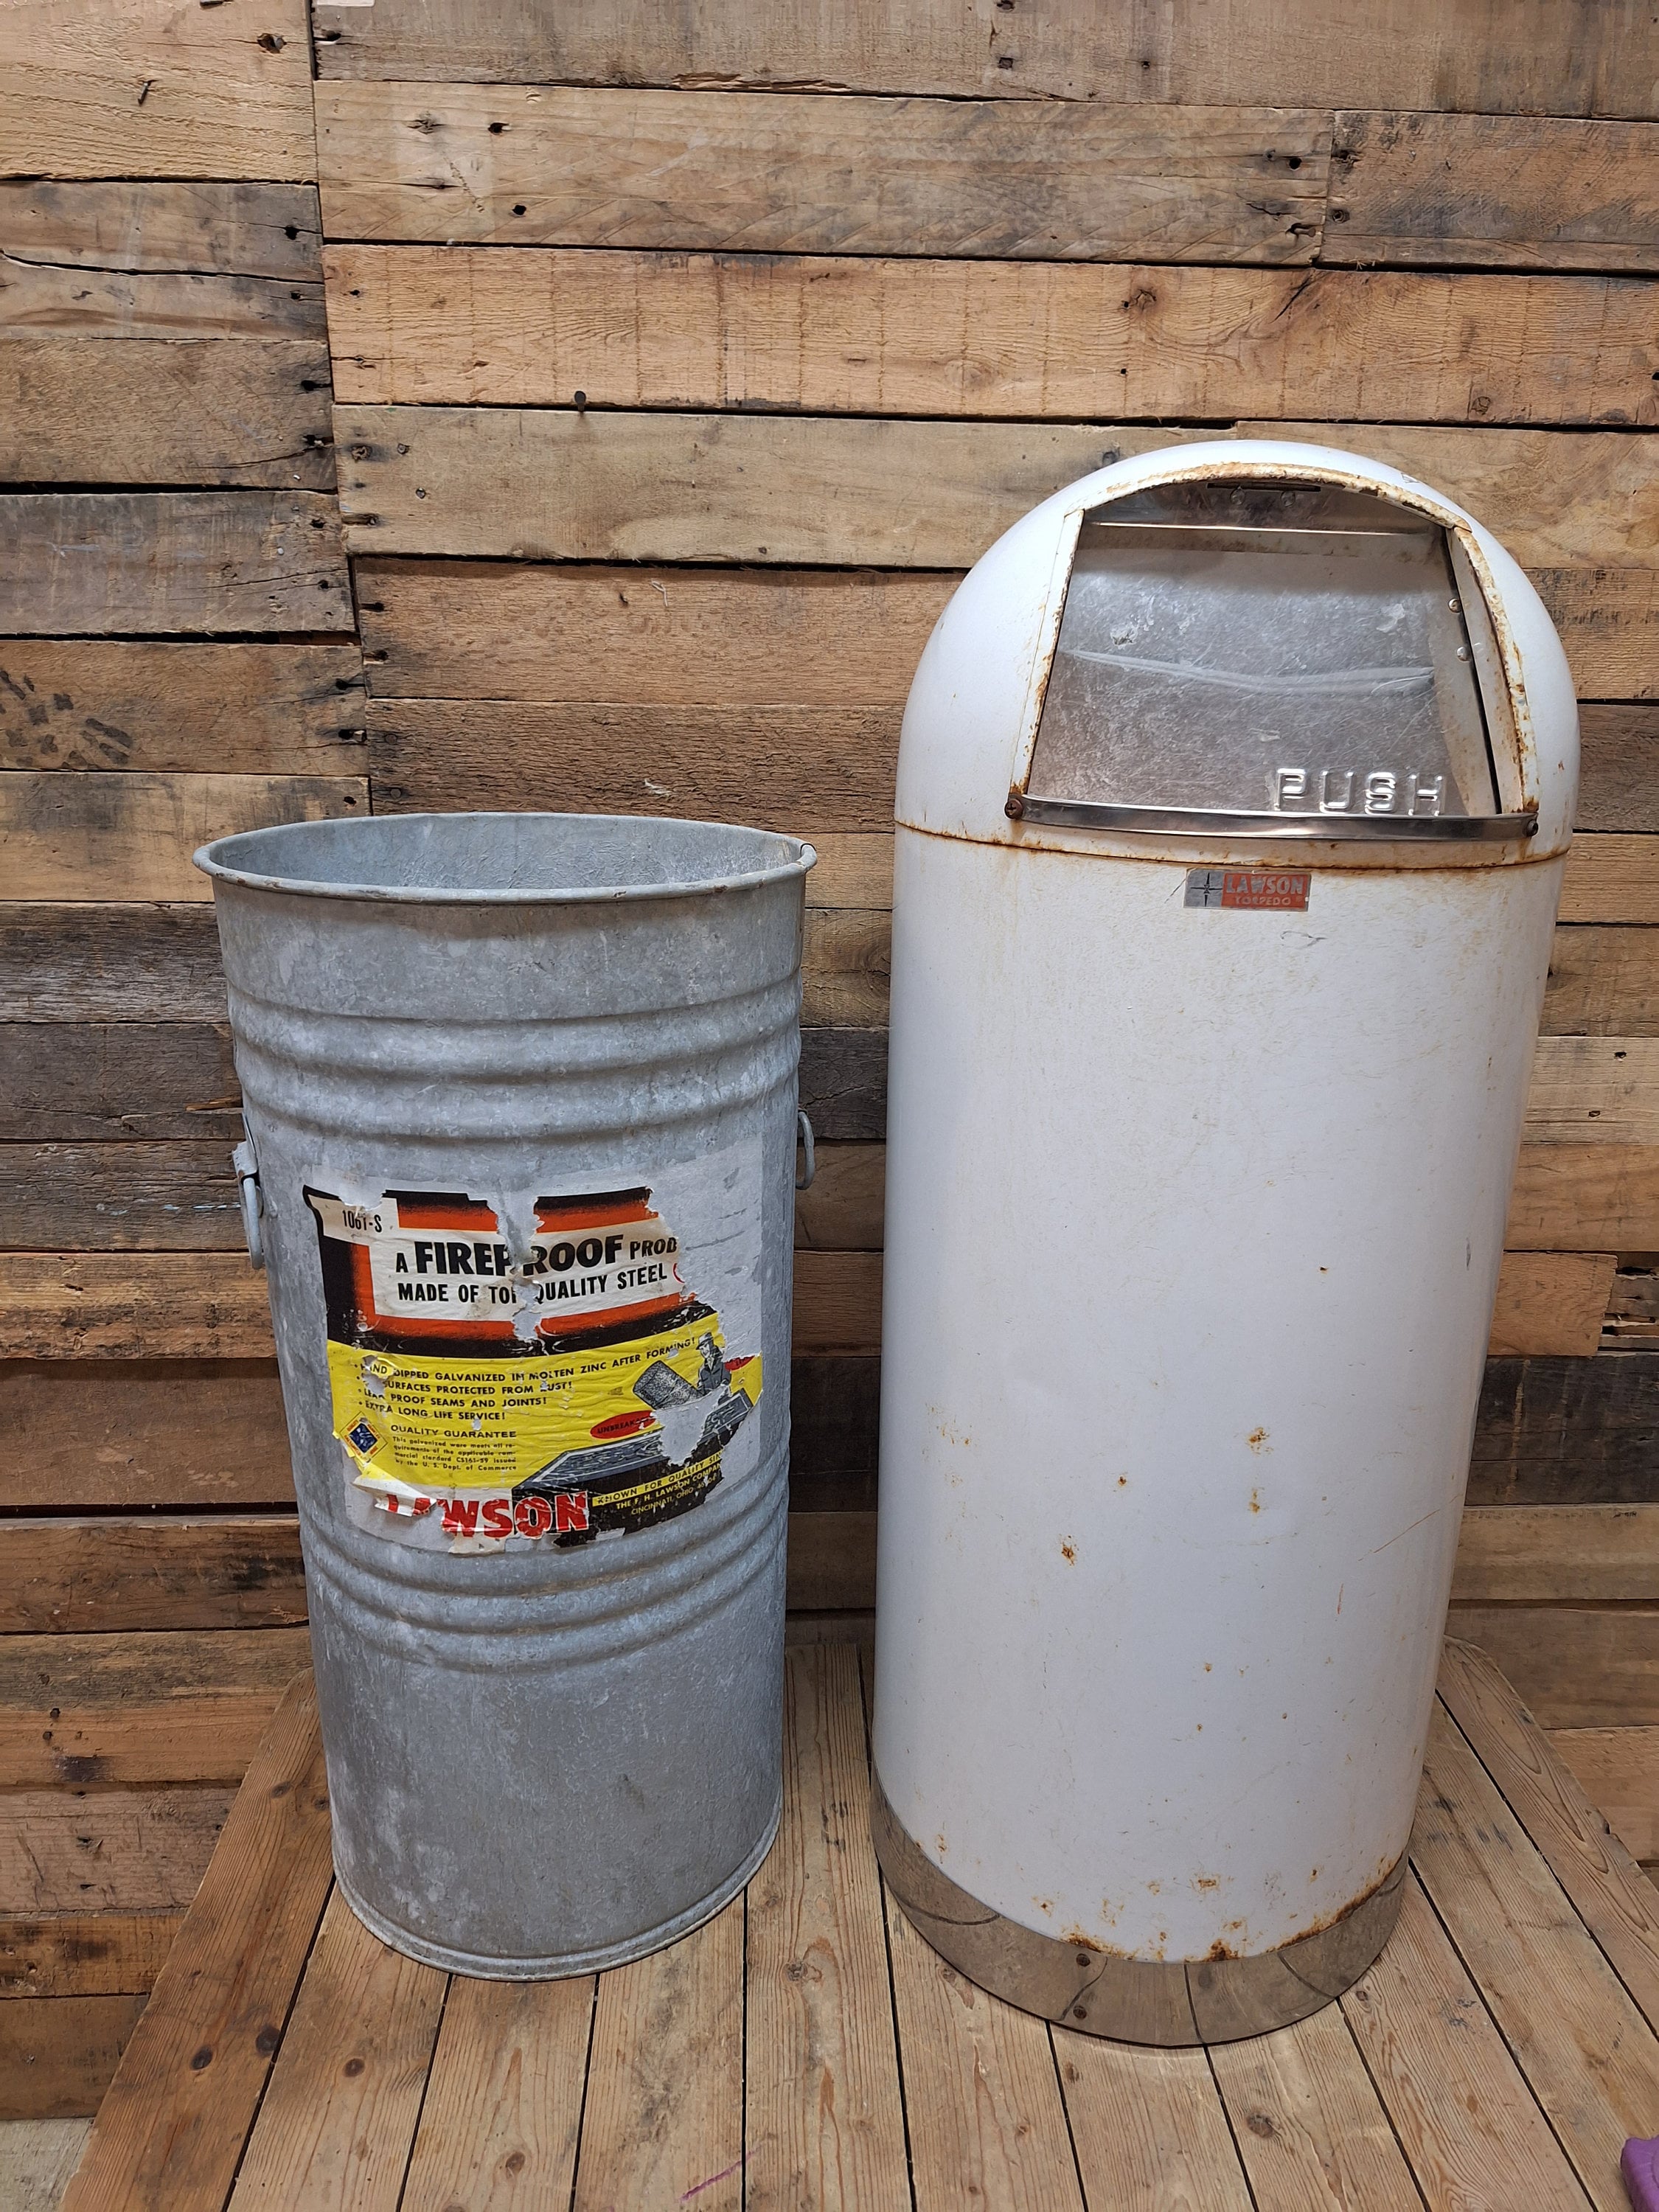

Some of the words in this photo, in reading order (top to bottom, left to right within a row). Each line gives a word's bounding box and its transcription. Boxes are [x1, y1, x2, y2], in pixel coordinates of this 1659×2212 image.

[1273, 768, 1443, 815] PUSH
[1226, 874, 1304, 894] LAWSON
[1235, 896, 1291, 905] TORPEDO
[342, 1210, 382, 1232] 1061-S
[396, 1253, 408, 1273] A
[414, 1234, 624, 1276] FIREPROOF
[397, 1283, 449, 1301] MADE
[458, 1284, 479, 1303] OF
[535, 1274, 608, 1305] QUALITY
[617, 1263, 667, 1290] STEEL
[361, 1363, 387, 1374] HND
[394, 1368, 429, 1379] DIPPED
[435, 1372, 505, 1382] GALVANIZED
[512, 1373, 524, 1381] IN
[529, 1368, 574, 1380] MOLTEN
[580, 1362, 606, 1374] ZINC
[612, 1354, 641, 1368] AFTER
[437, 1385, 495, 1394] PROTECTED
[502, 1385, 533, 1394] FROM
[366, 1400, 393, 1413] EXTRA
[399, 1407, 428, 1416] LONG
[434, 1411, 453, 1419] LIFE
[458, 1411, 506, 1420] SERVICE!
[391, 1394, 425, 1405] PROOF
[431, 1398, 465, 1407] SEAMS
[470, 1399, 495, 1408] AND
[501, 1397, 546, 1407] JOINTS!
[391, 1425, 439, 1435] QUALITY
[597, 1417, 650, 1433] UNBREAK
[409, 1439, 446, 1447] galvanized
[597, 1488, 637, 1505] KNOWN
[644, 1481, 662, 1492] FOR
[669, 1461, 704, 1483] QUALITY
[676, 1487, 693, 1499] OHIO
[616, 1500, 632, 1509] THE
[656, 1479, 689, 1498] LAWSON
